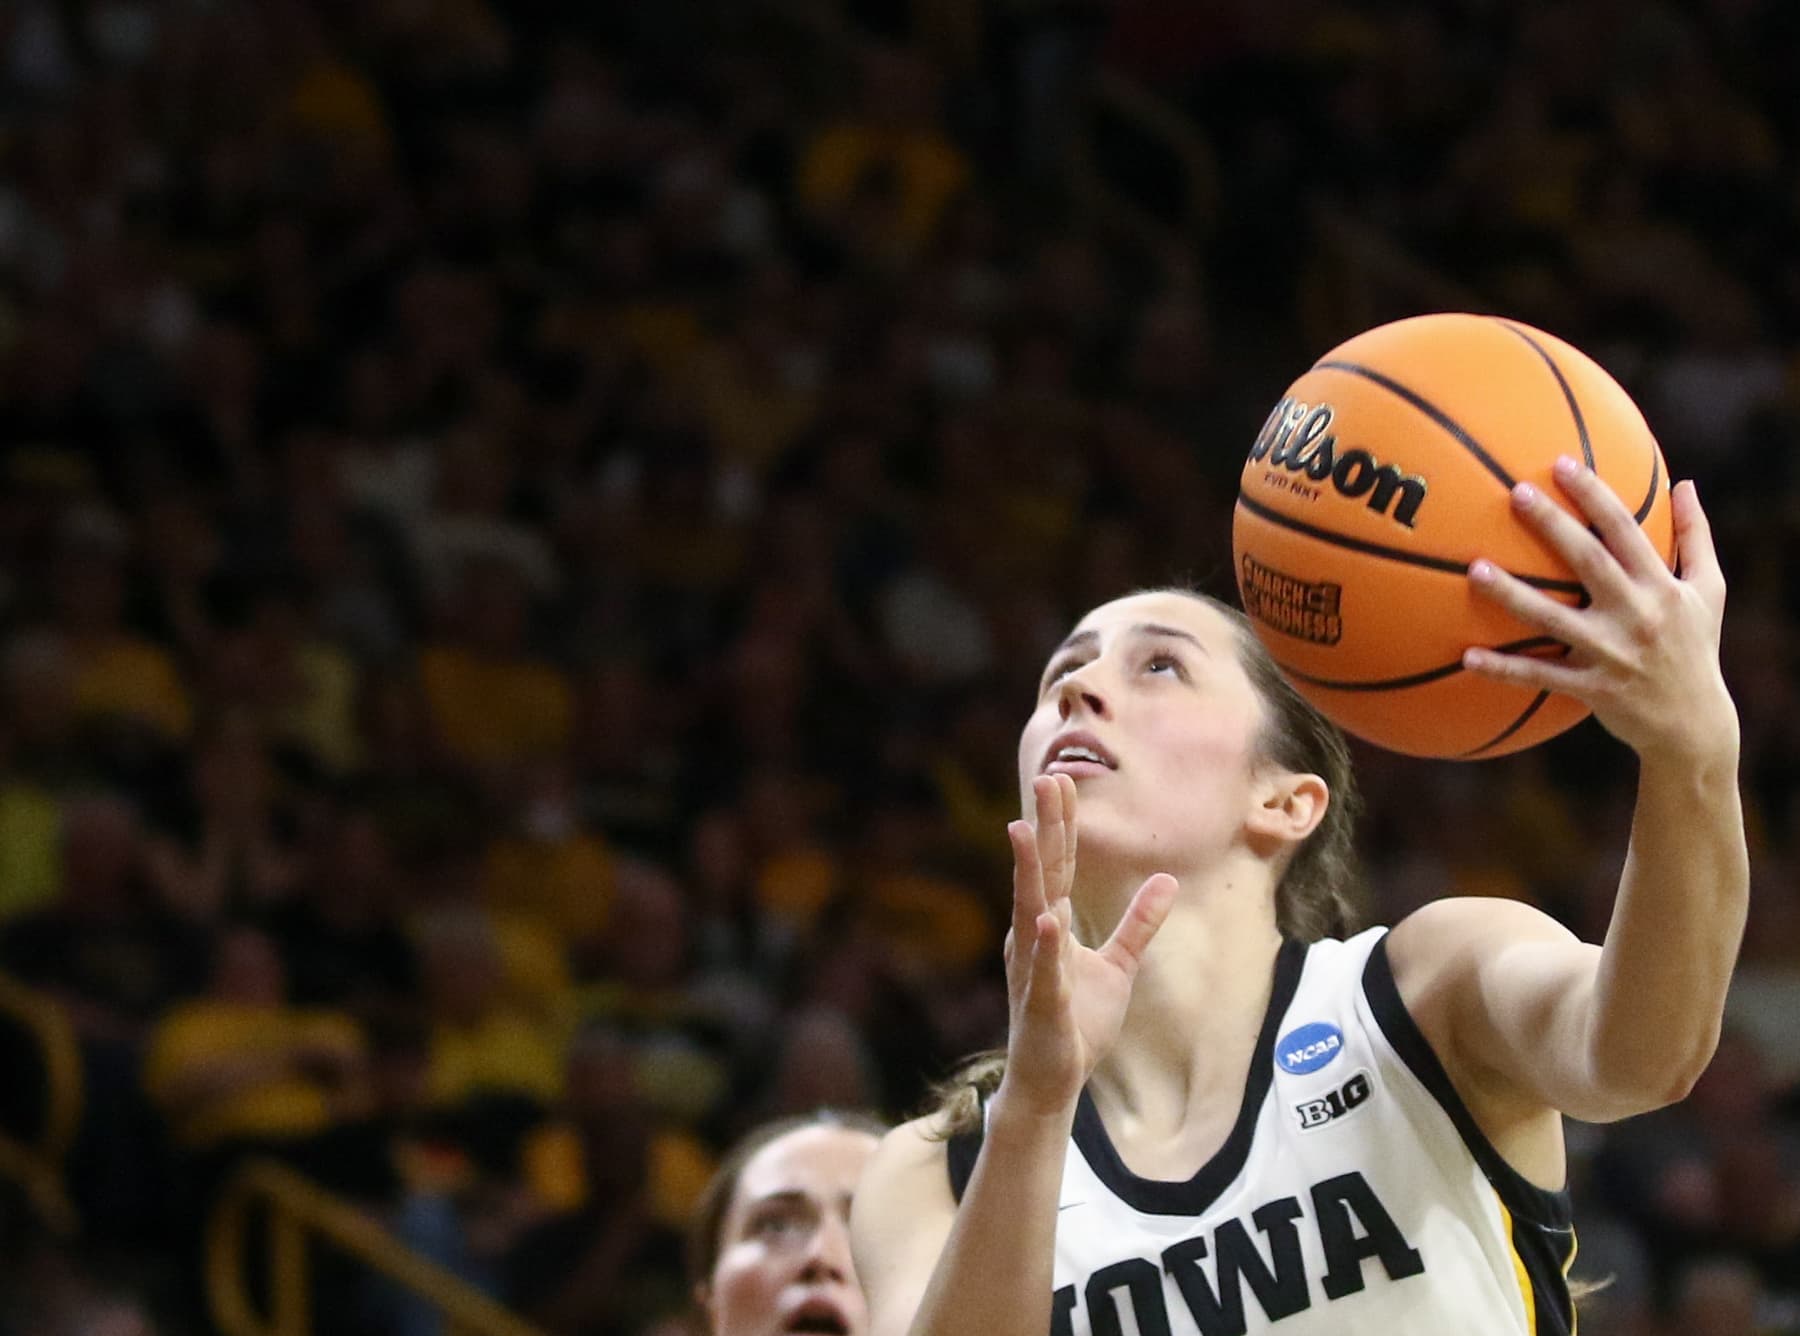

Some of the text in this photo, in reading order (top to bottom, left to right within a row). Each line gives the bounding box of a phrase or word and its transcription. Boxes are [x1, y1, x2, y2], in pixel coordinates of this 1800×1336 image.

[1252, 563, 1305, 610] MARCH
[1259, 592, 1339, 641] MADNESS
[1286, 1034, 1340, 1068] NCAA
